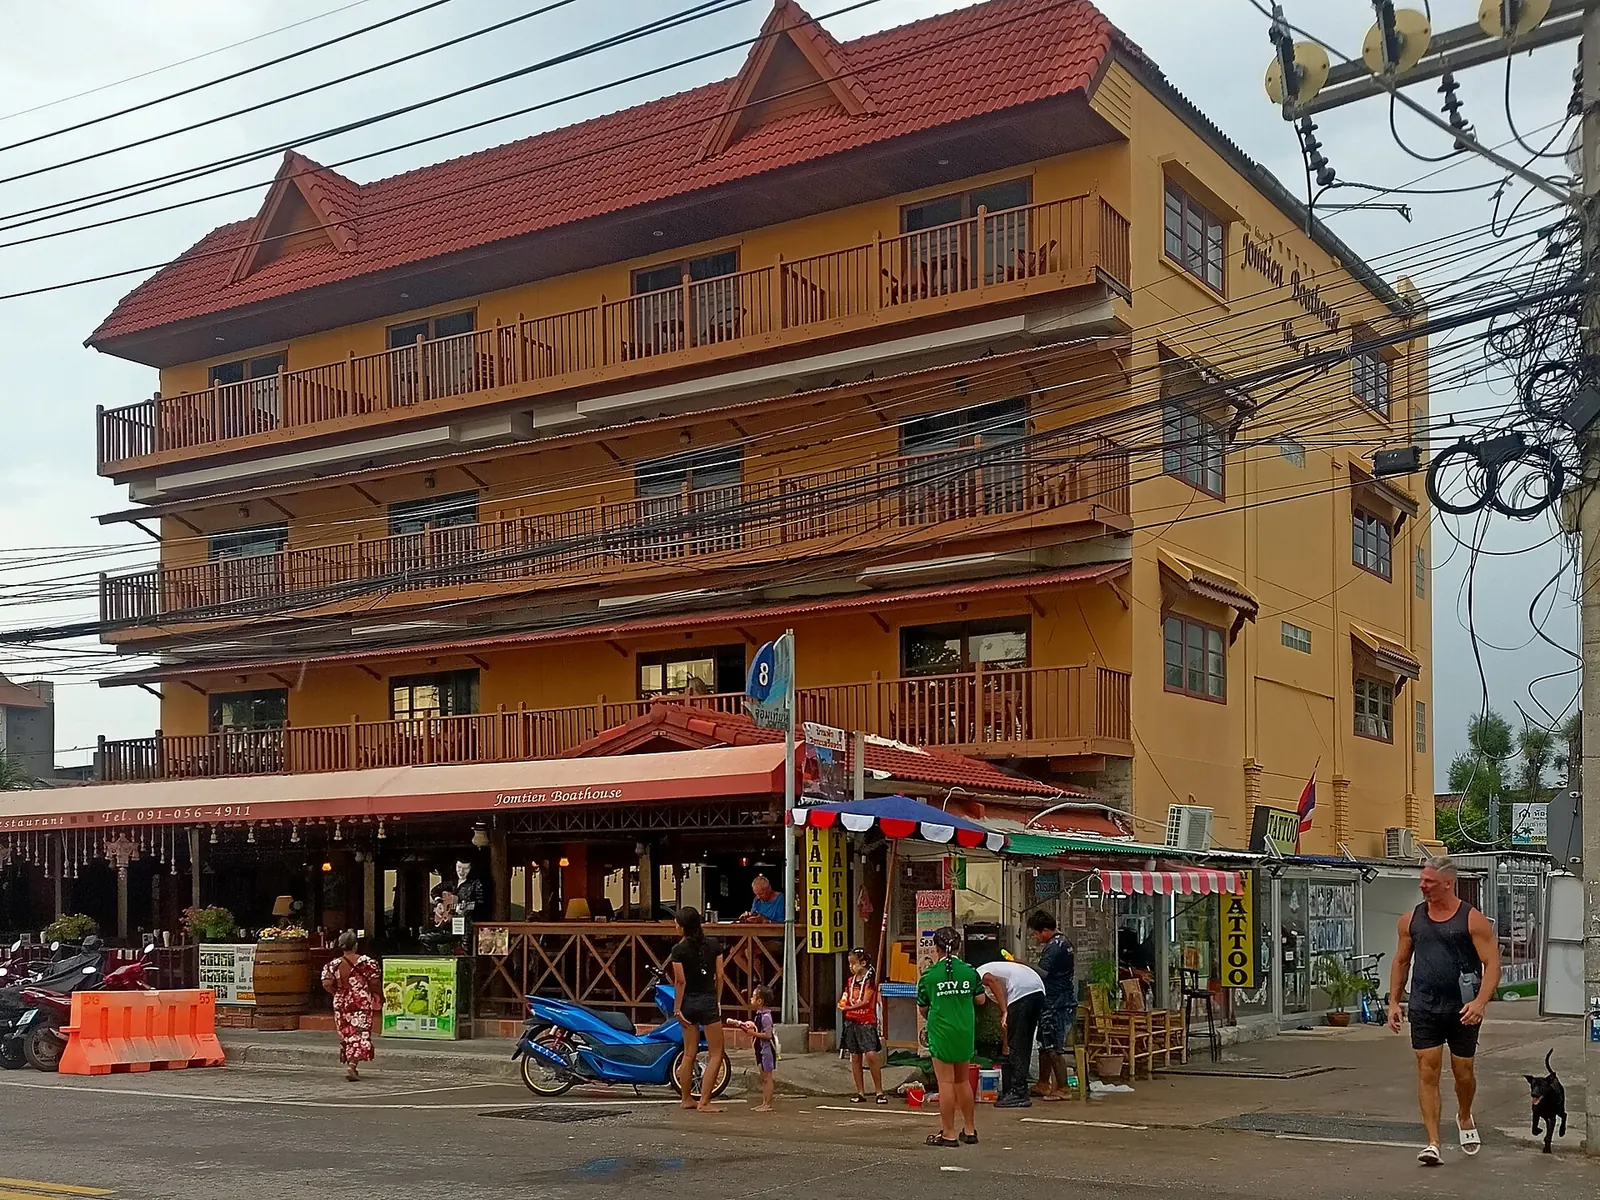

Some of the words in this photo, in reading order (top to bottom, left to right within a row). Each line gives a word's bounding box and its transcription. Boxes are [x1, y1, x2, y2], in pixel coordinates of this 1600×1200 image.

[759, 662, 769, 686] 8
[493, 791, 547, 807] Jomtien
[551, 786, 622, 803] Boathouse
[102, 810, 132, 823] Tel.
[137, 805, 251, 821] 091-056-4911
[1269, 813, 1299, 844] TATTOO
[808, 826, 823, 949] TATTOO
[832, 831, 843, 948] TATTOO
[936, 981, 958, 991] PTY
[962, 980, 970, 989] 8
[936, 989, 959, 997] SPORTS
